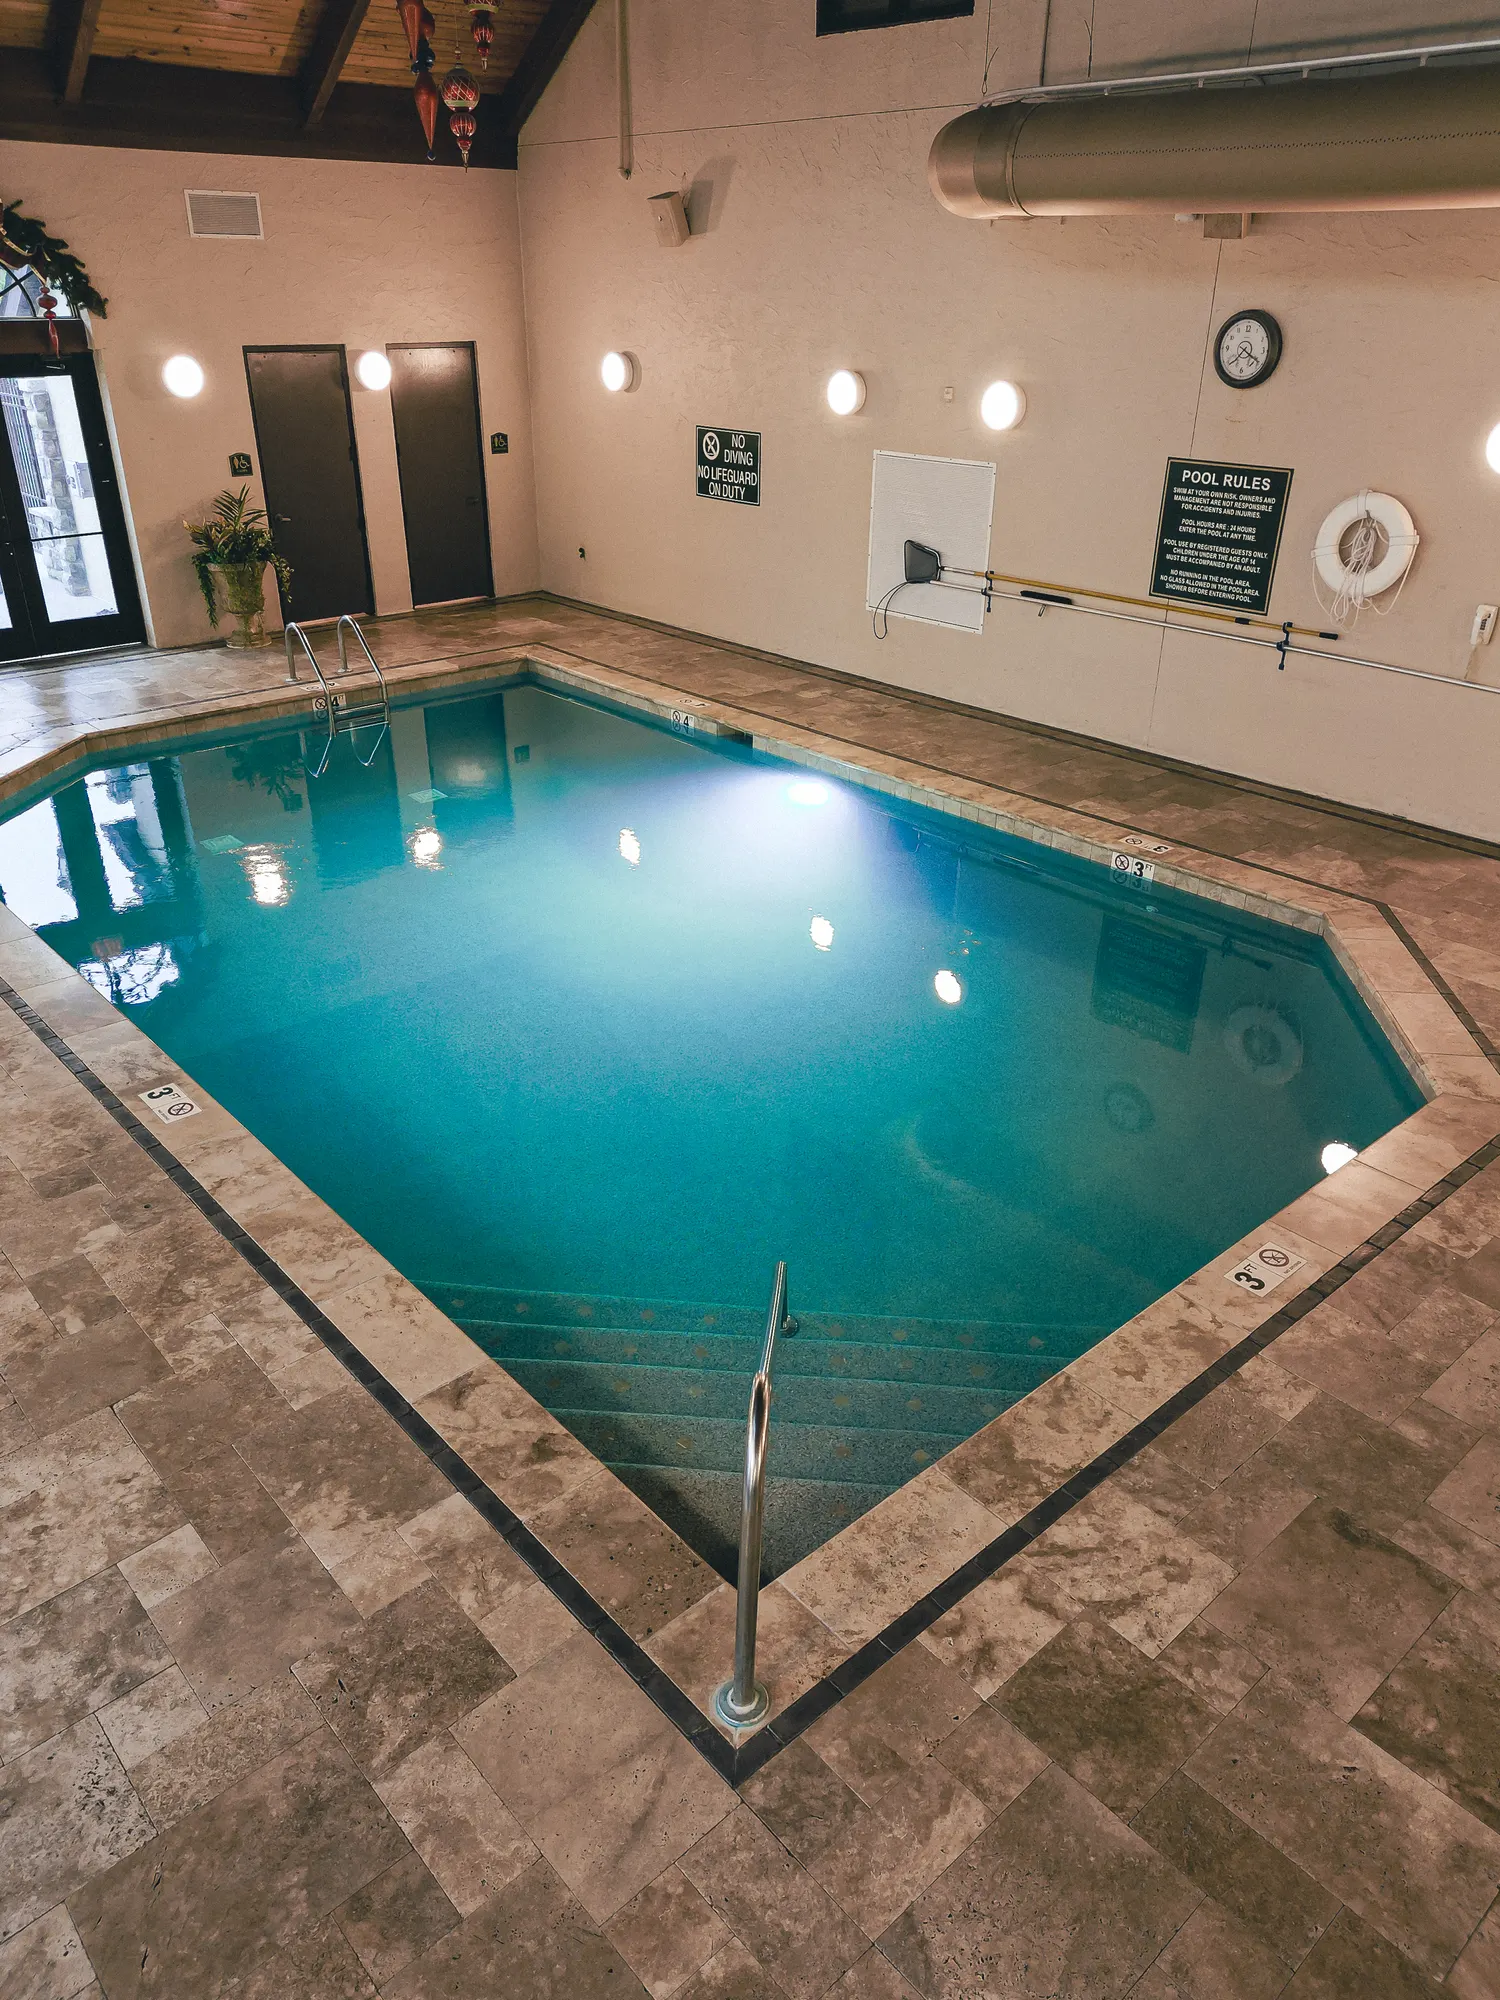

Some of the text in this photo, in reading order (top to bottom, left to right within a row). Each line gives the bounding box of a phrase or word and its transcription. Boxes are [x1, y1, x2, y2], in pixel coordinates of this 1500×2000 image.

[732, 434, 745, 449] NO
[724, 450, 753, 466] DIVING
[698, 465, 757, 486] NO LIFEGUARD
[1182, 470, 1271, 491] POOL RULES
[709, 482, 746, 500] ON DUTY
[1224, 492, 1238, 500] RISK.
[1239, 494, 1263, 503] OWNERS
[1174, 495, 1210, 504] MANAGEMENT
[1234, 502, 1273, 512] RESPONSIBLE
[1193, 505, 1222, 514] ACCIDENTS
[1235, 510, 1261, 519] INJURIES.
[1179, 526, 1196, 534] ENTER
[1208, 529, 1222, 537] POOL
[1182, 518, 1196, 526] POOL
[1196, 520, 1215, 528] HOURS
[1237, 526, 1256, 534] HOURS
[1173, 547, 1198, 556] CHILDREN
[1199, 550, 1217, 559] UNDER
[1197, 543, 1230, 553] REGISTERED
[1231, 548, 1252, 556] GUESTS
[1253, 551, 1268, 559] ONLY.
[1188, 557, 1225, 568] ACCOMPANIED
[1242, 565, 1260, 573] ADULT.
[1179, 570, 1201, 579] RUNNING
[1220, 576, 1234, 585] POOL
[1165, 583, 1252, 603] SHOWER BEFORE ENTERING POOL.
[1169, 576, 1185, 584] GLASS
[1186, 579, 1210, 588] ALLOWED
[1243, 588, 1260, 596] AREA.
[332, 696, 339, 706] 4
[683, 715, 690, 726] 4
[1133, 861, 1144, 877] 3
[147, 1087, 173, 1099] 3
[1234, 1263, 1265, 1290] 3 FT
